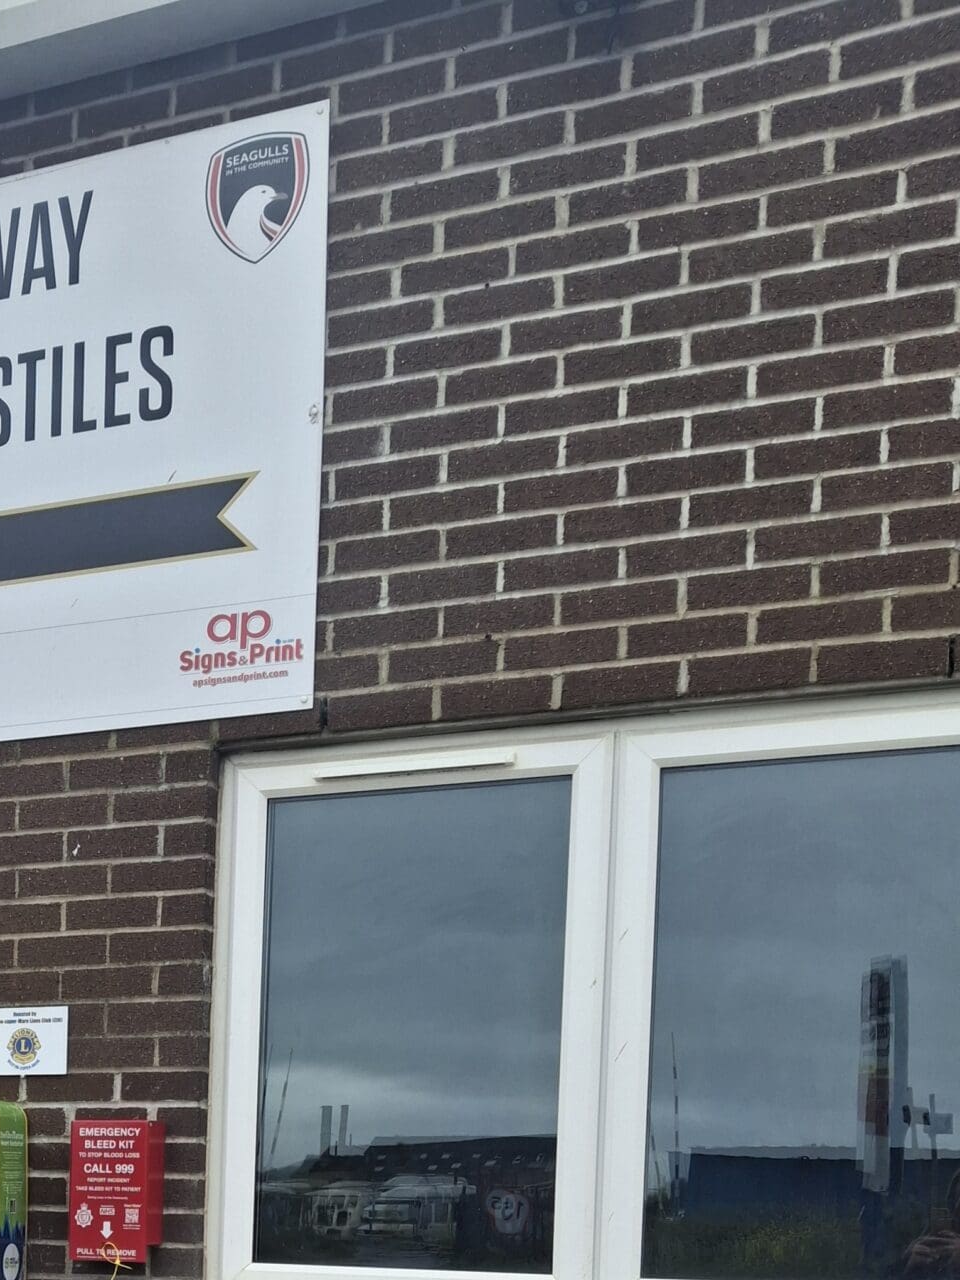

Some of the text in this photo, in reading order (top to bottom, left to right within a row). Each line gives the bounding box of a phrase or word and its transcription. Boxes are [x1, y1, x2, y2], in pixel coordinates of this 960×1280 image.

[226, 144, 289, 168] SEAGULLS
[225, 156, 289, 176] IN THE COMMUNITY
[207, 609, 272, 650] ap
[192, 670, 289, 688] apsignsandprint.com
[20, 1039, 29, 1052] L
[79, 1127, 141, 1136] EMERGENCY
[84, 1140, 135, 1149] BLEED KIT
[83, 1163, 135, 1174] CALL 999
[107, 1249, 136, 1257] REMOVE
